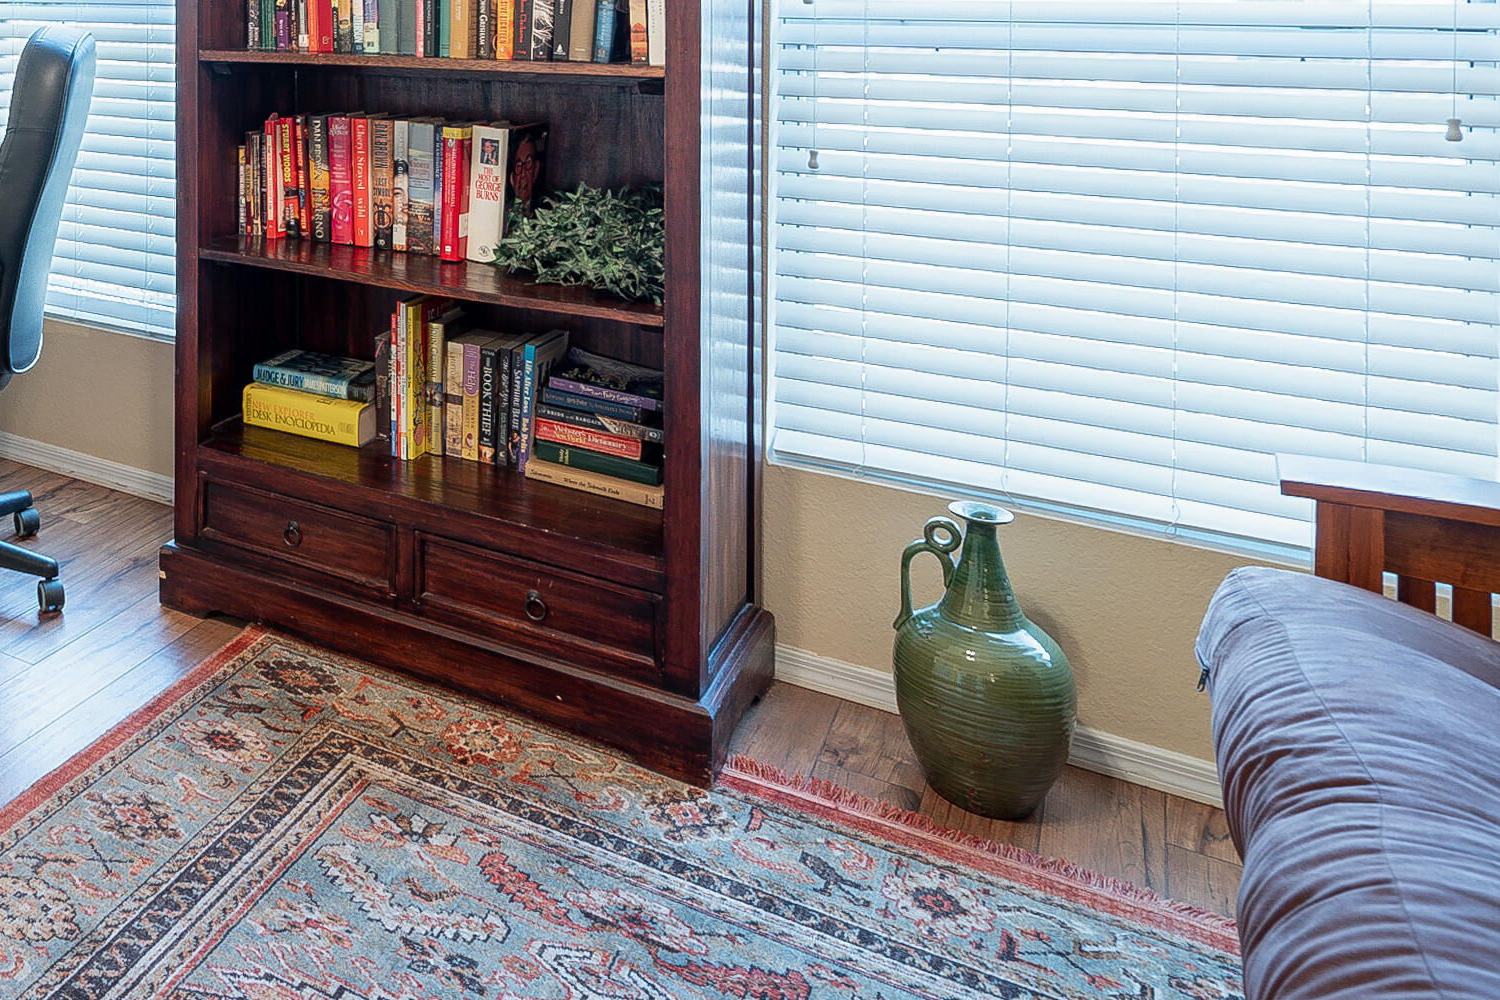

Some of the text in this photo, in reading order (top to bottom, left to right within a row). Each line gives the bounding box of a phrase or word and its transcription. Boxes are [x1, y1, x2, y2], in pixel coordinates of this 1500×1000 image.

[479, 15, 487, 45] GRISHAM
[282, 124, 291, 182] STUART WOODS
[374, 124, 388, 169] DAN BROWN
[312, 120, 326, 239] DAN BROWN INFERNO
[355, 124, 366, 218] Cheryl Strayed wild
[483, 167, 494, 175] THE
[475, 180, 501, 192] GEORGE
[476, 189, 499, 201] BURNS
[256, 367, 279, 385] JUDGE
[280, 373, 286, 384] &
[287, 374, 304, 388] JURY
[466, 370, 475, 390] Help
[482, 367, 492, 399] BOOK
[252, 400, 315, 420] NEW EXPLORER
[512, 369, 522, 430] SAPPHIRE BLUE
[252, 409, 272, 421] DESK
[275, 414, 335, 435] ENCYCLOPEDIA
[482, 402, 491, 435] THIEF
[522, 417, 530, 432] Bob
[547, 410, 564, 418] BRIDE
[554, 424, 627, 451] Webster's Dictionary
